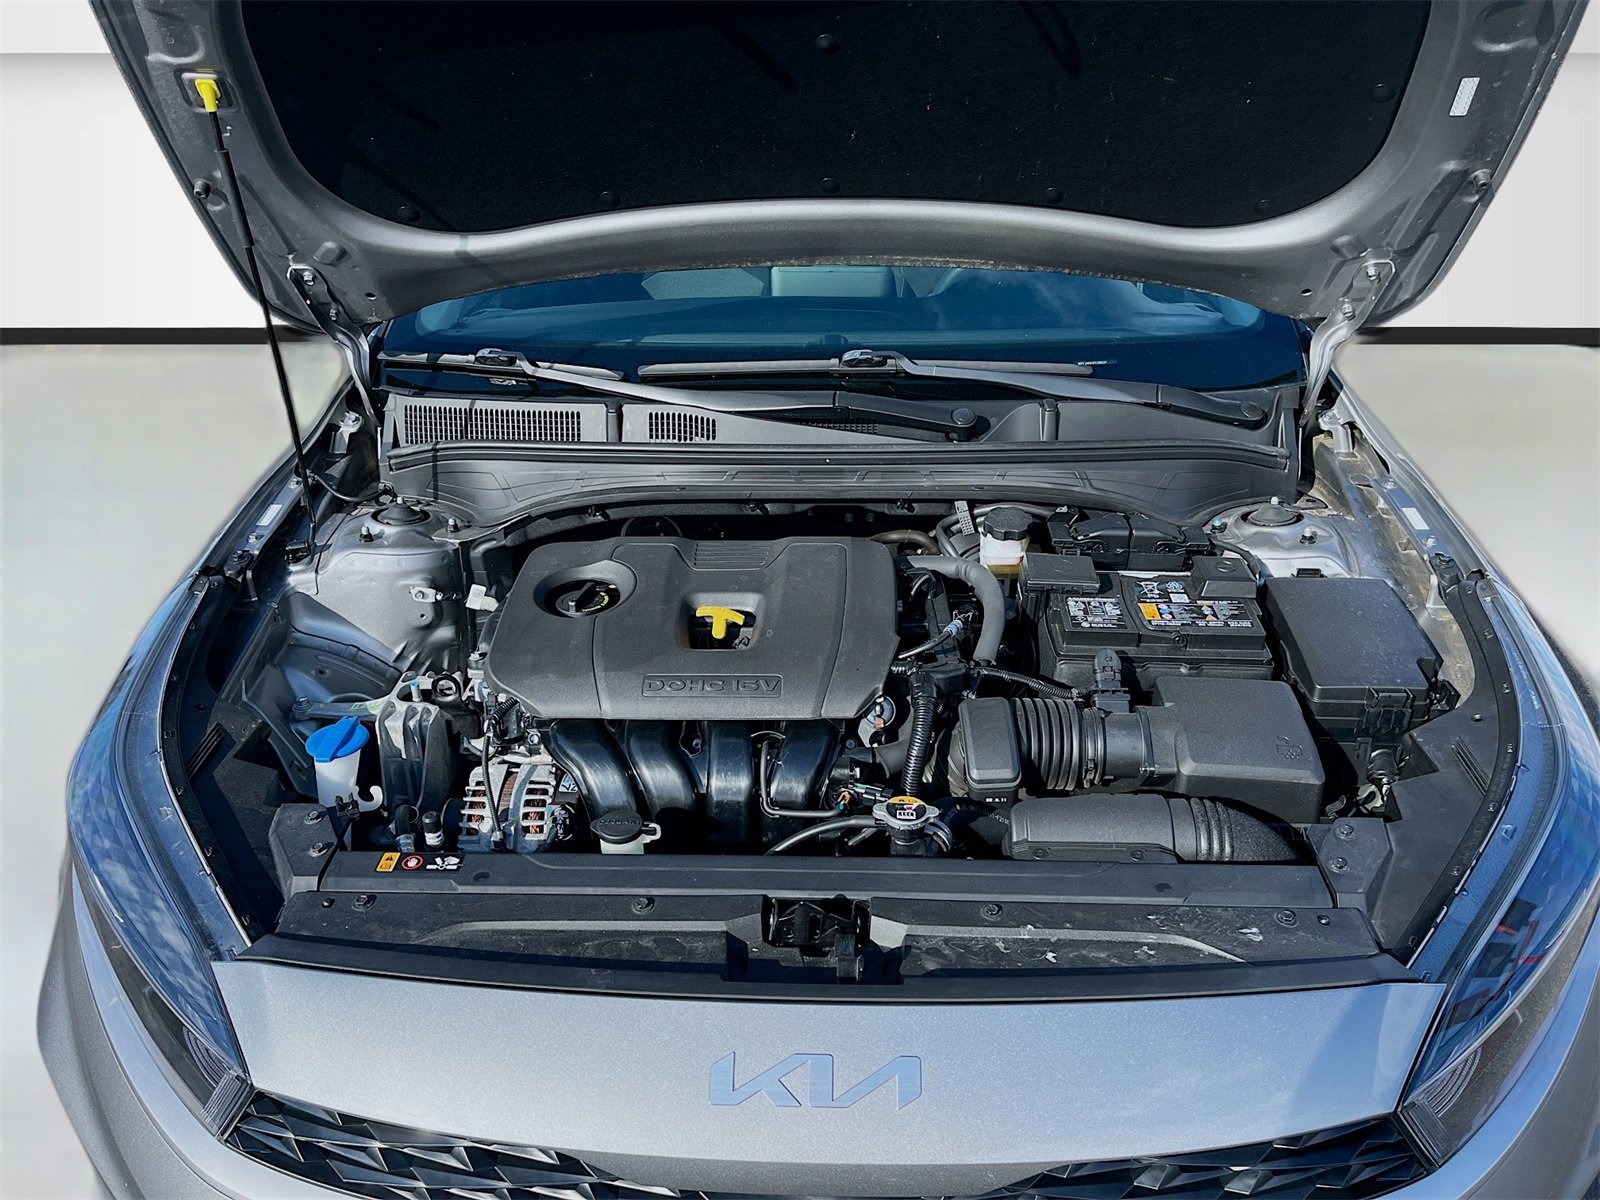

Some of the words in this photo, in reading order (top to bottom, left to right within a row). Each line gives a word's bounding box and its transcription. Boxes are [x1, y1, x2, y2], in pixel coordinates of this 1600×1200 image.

[645, 679, 725, 692] DOHC
[731, 679, 781, 692] 16V
[708, 1051, 923, 1110] KIA
